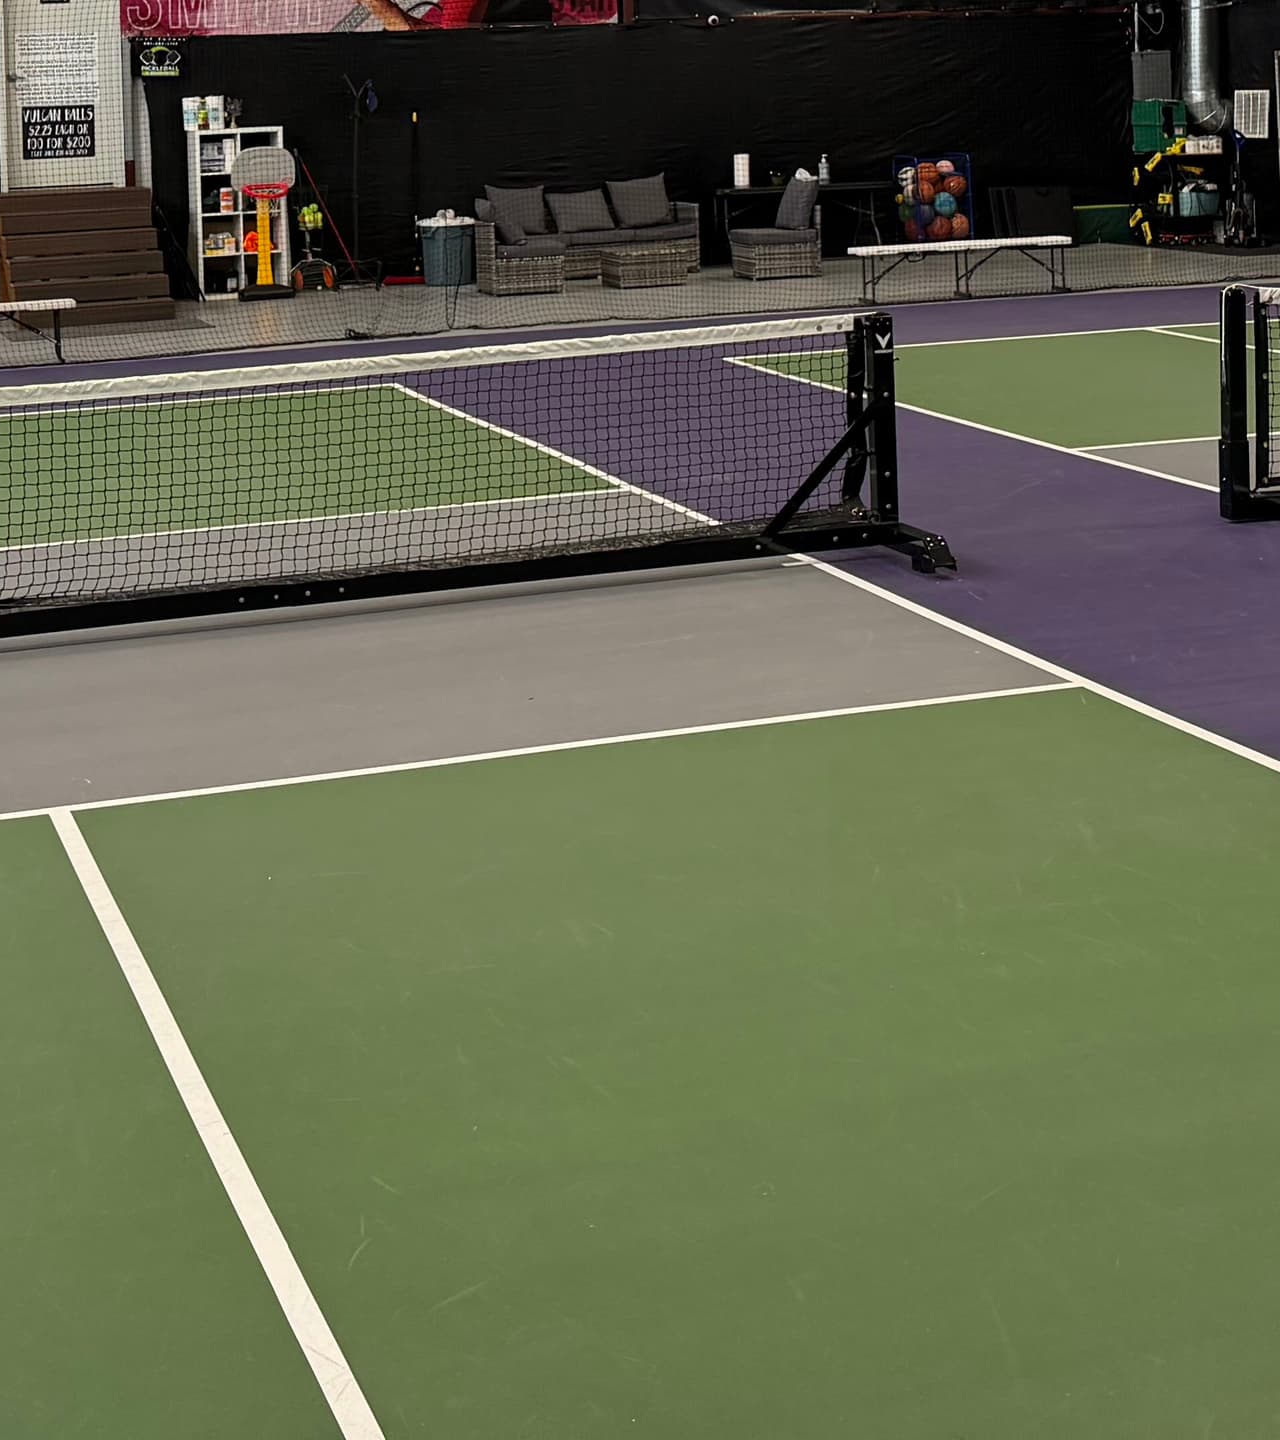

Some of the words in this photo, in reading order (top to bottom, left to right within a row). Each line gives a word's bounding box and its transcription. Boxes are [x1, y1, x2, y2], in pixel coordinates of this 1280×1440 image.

[23, 108, 61, 123] VULCAN
[64, 107, 93, 121] BALLS
[27, 137, 43, 150] 100
[46, 137, 64, 149] FOR
[66, 135, 91, 149] $200
